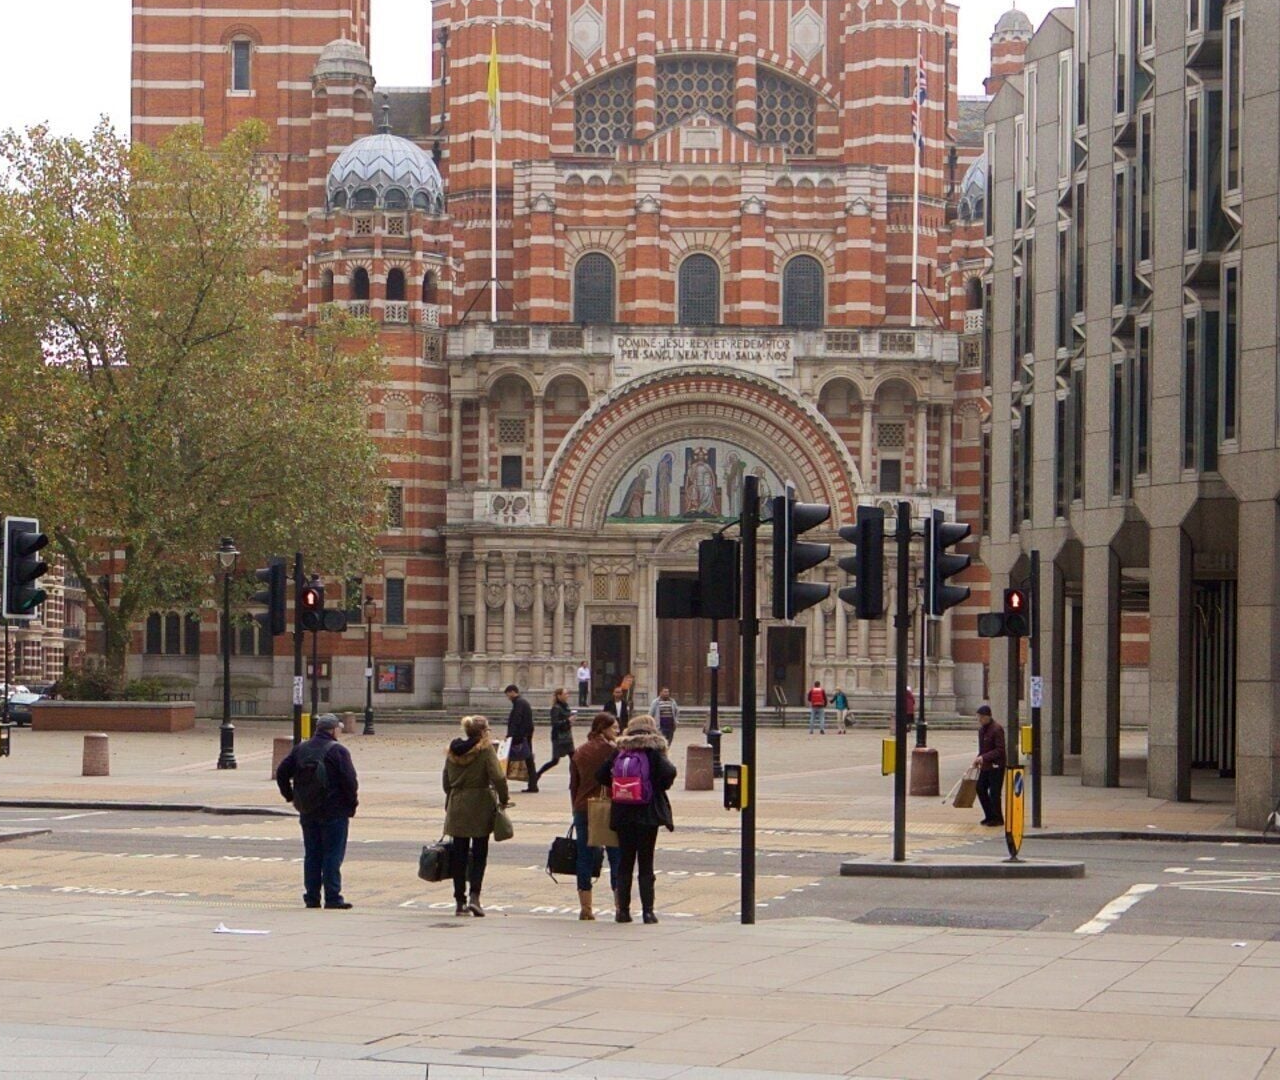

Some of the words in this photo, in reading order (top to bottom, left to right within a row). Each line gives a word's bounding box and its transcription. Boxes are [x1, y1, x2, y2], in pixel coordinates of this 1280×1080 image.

[618, 337, 657, 349] DOMINE
[660, 337, 685, 349] JESU
[690, 338, 709, 349] REX
[714, 339, 726, 349] ET
[621, 349, 639, 360] PER
[703, 350, 732, 361] TUUM
[735, 351, 763, 362] SALVA
[766, 351, 789, 362] NOS
[399, 900, 509, 912] LOK
